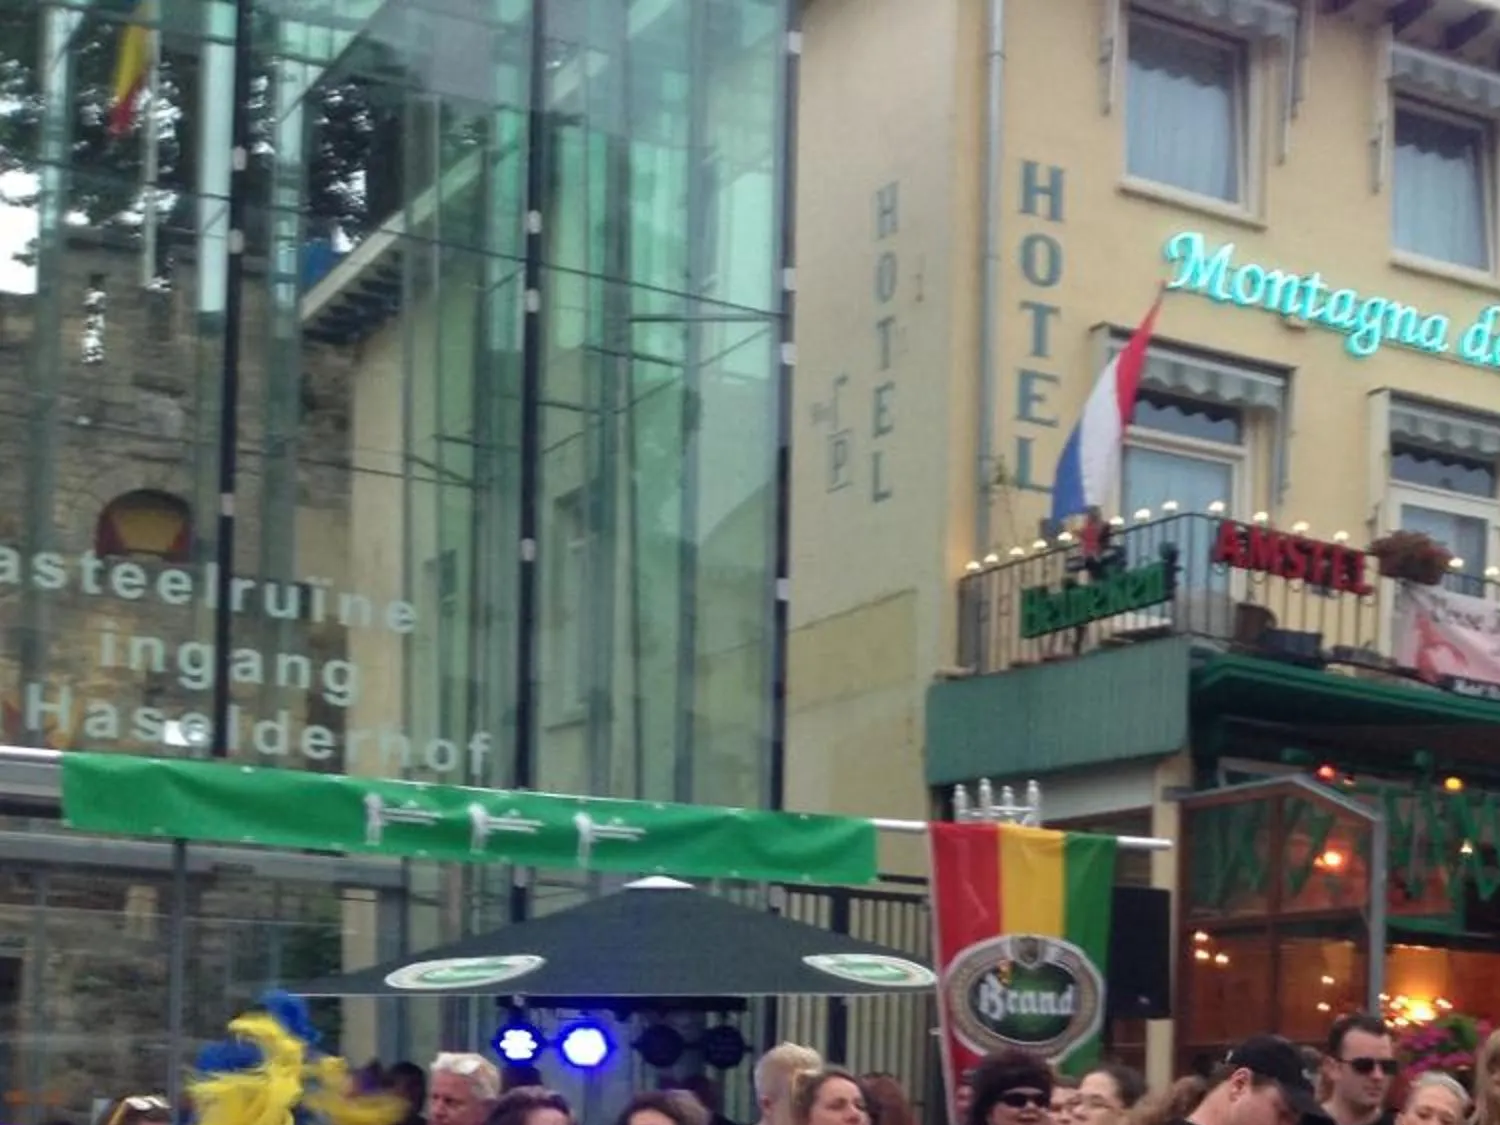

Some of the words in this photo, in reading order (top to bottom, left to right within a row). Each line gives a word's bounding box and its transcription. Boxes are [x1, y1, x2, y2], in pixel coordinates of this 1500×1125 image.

[1013, 160, 1066, 497] HOTEL
[1166, 231, 1450, 357] Montagna
[871, 181, 899, 503] HOTEL
[1212, 519, 1374, 596] AMSTEL
[101, 621, 358, 707] ingang
[25, 682, 492, 775] Haselderhof
[978, 972, 1077, 1021] Brand
